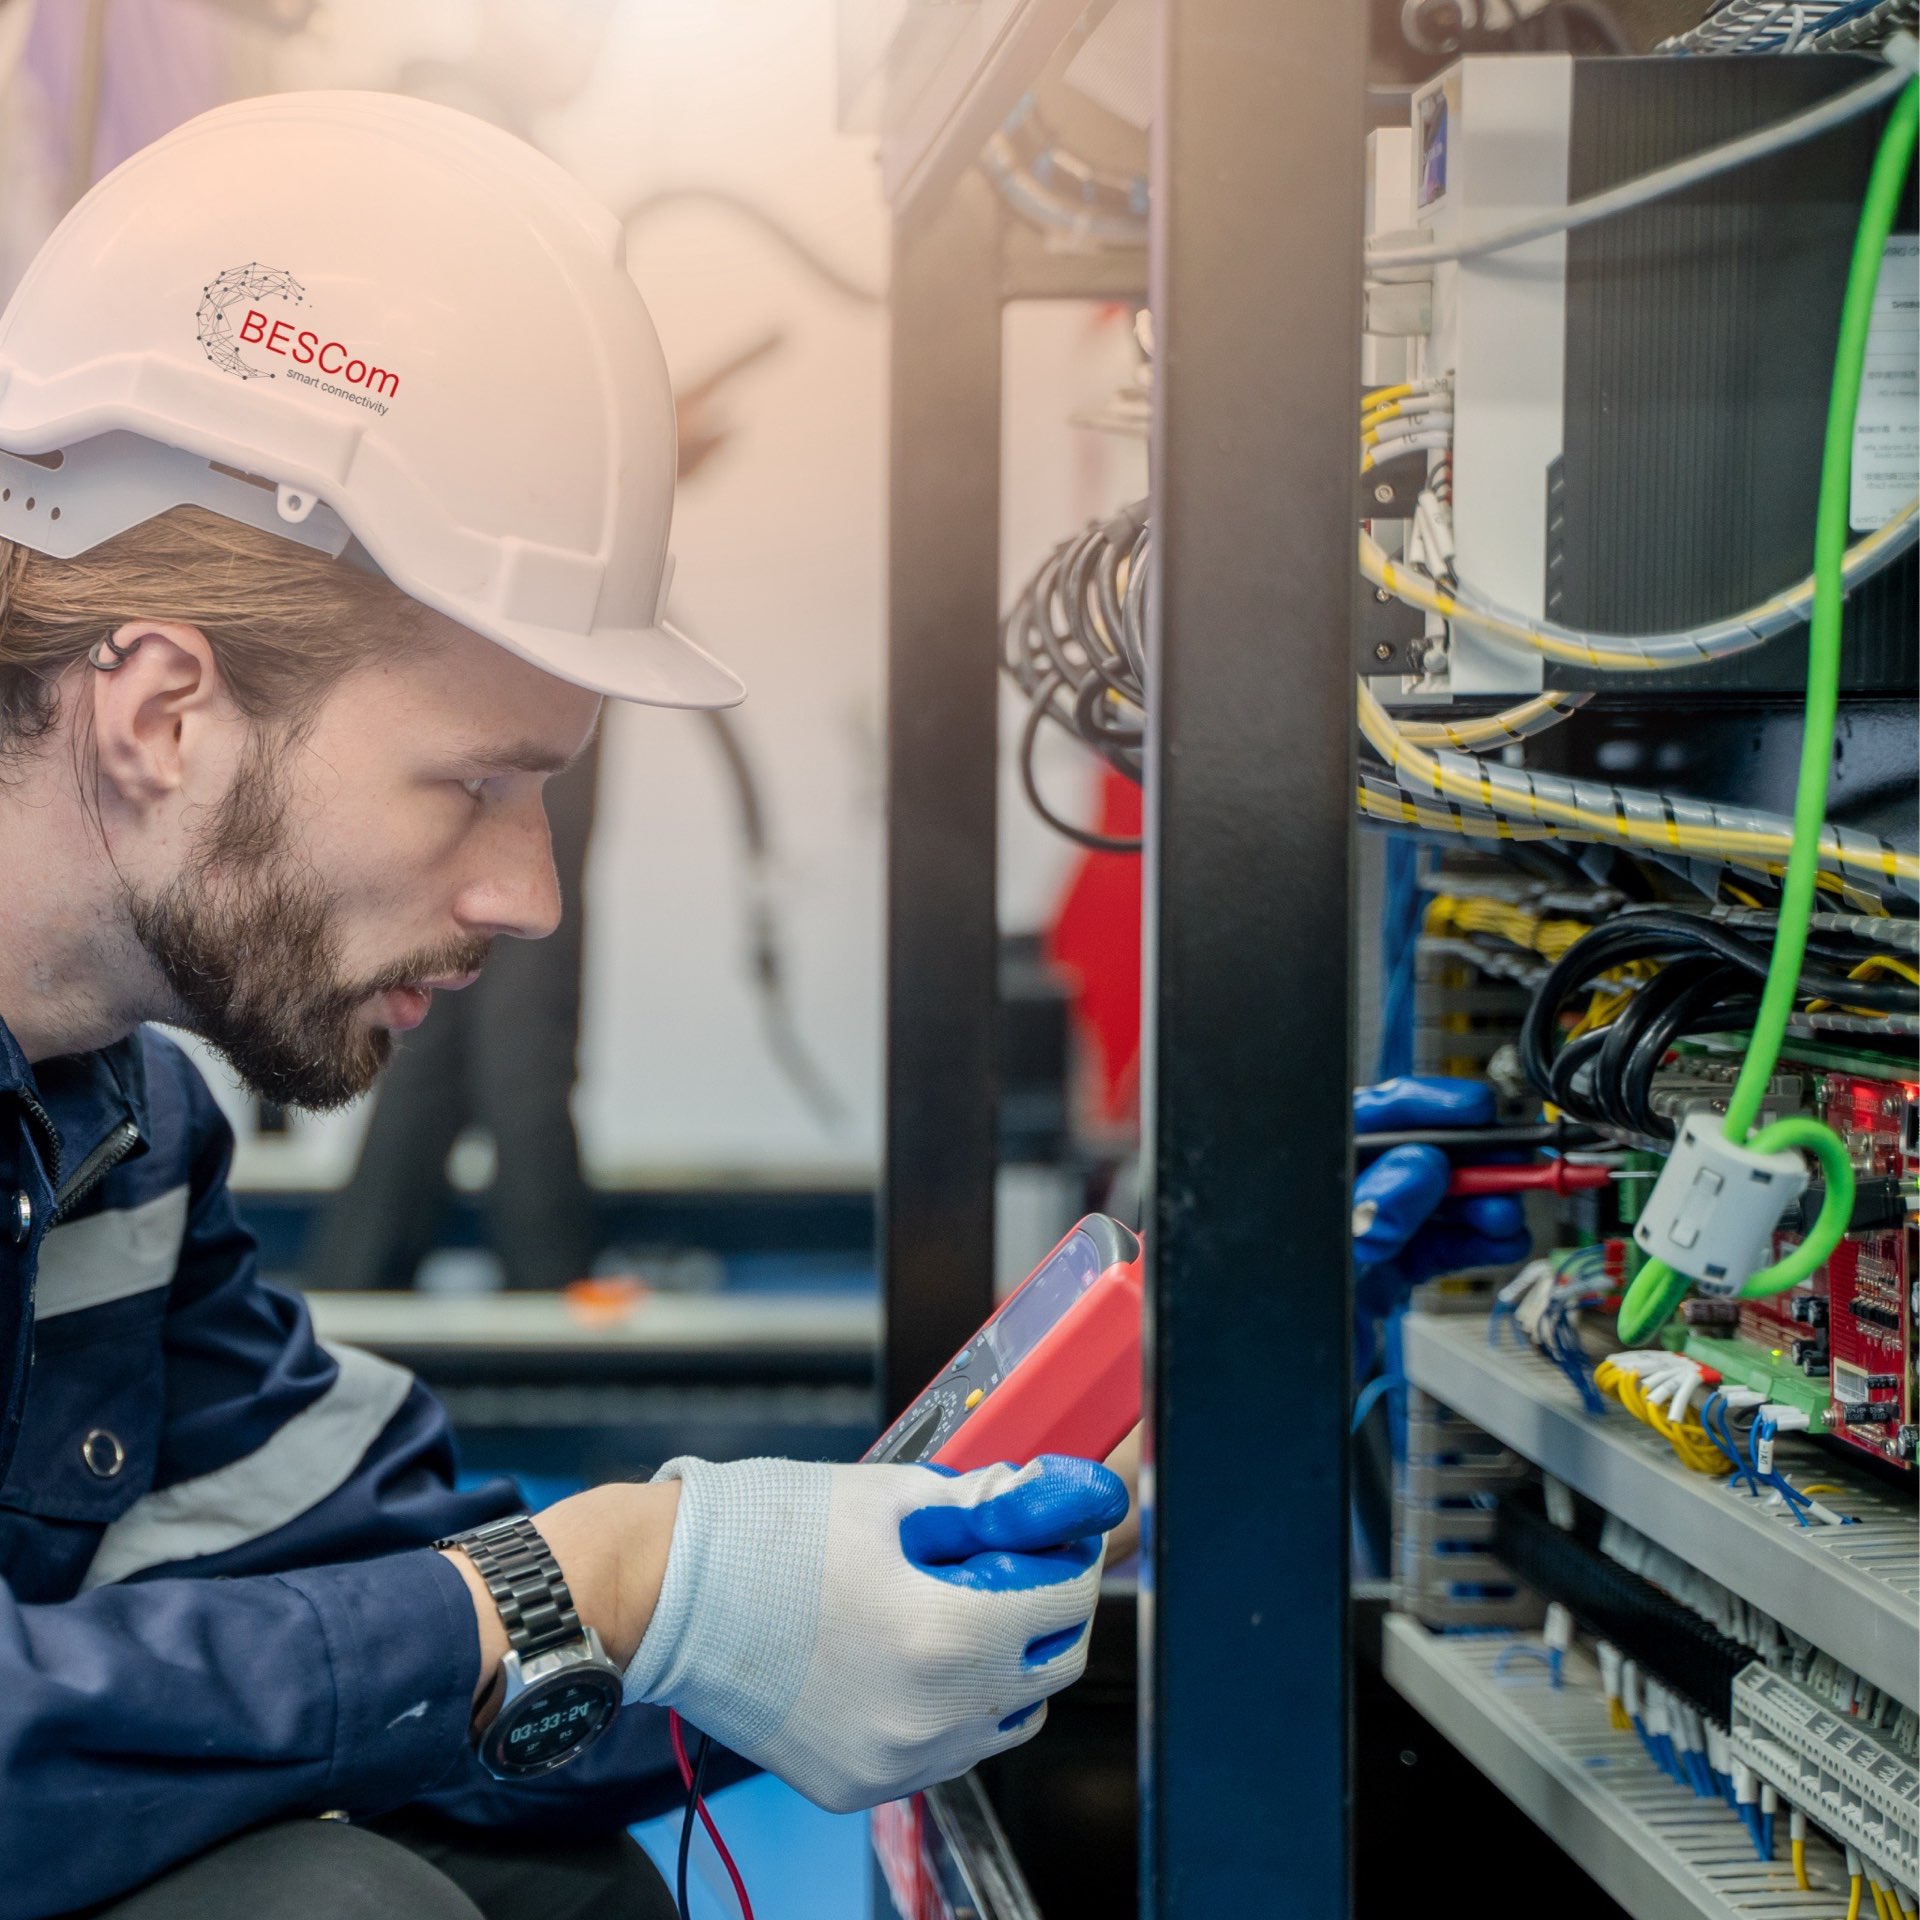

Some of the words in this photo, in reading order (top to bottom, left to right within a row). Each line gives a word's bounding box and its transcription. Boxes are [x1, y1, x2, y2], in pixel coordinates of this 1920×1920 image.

[239, 310, 400, 398] BESCom
[286, 368, 319, 389] smart
[321, 381, 389, 417] connectivity
